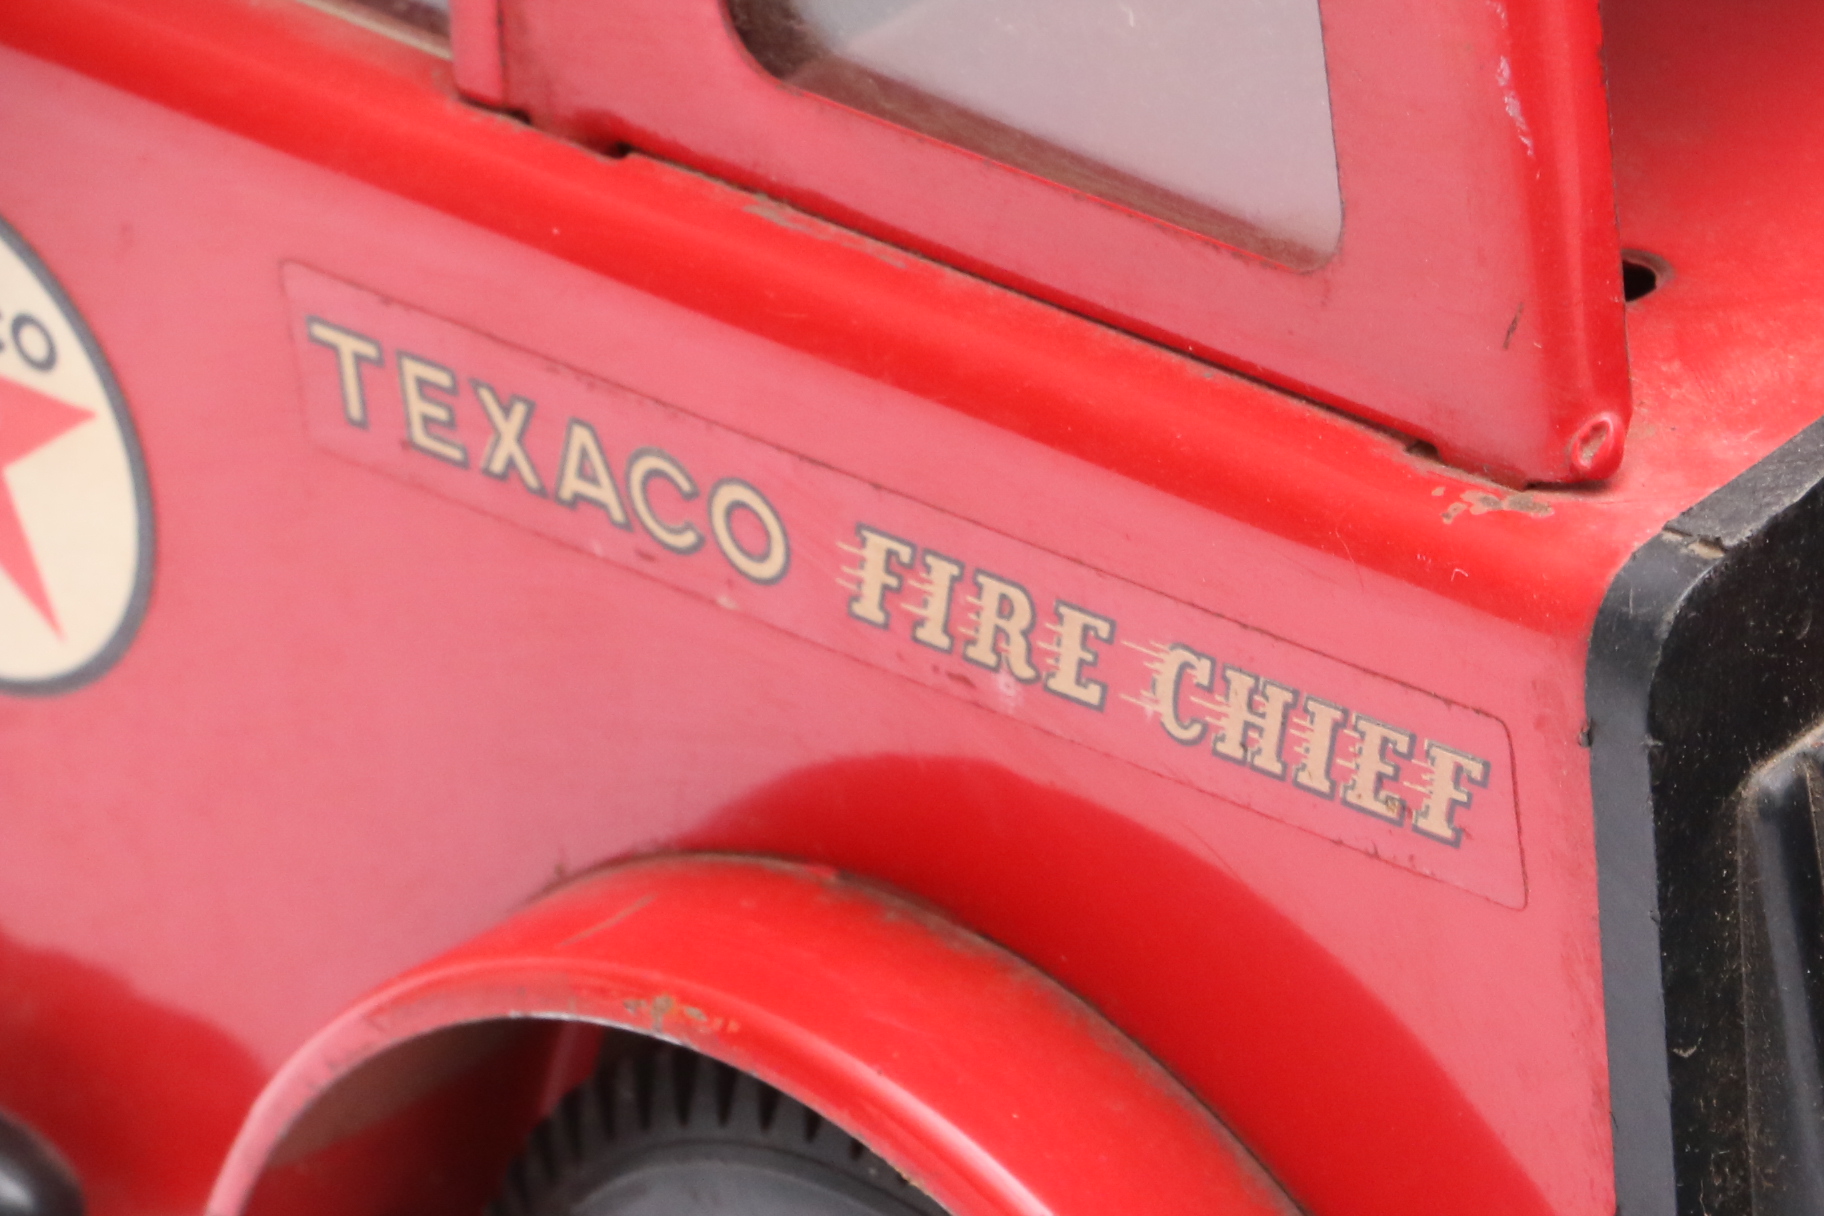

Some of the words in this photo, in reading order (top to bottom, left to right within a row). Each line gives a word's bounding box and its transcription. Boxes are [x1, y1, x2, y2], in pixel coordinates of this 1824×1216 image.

[305, 315, 791, 587] TEXACO
[838, 523, 1116, 712] FIRE
[1132, 639, 1491, 848] CHIEF
